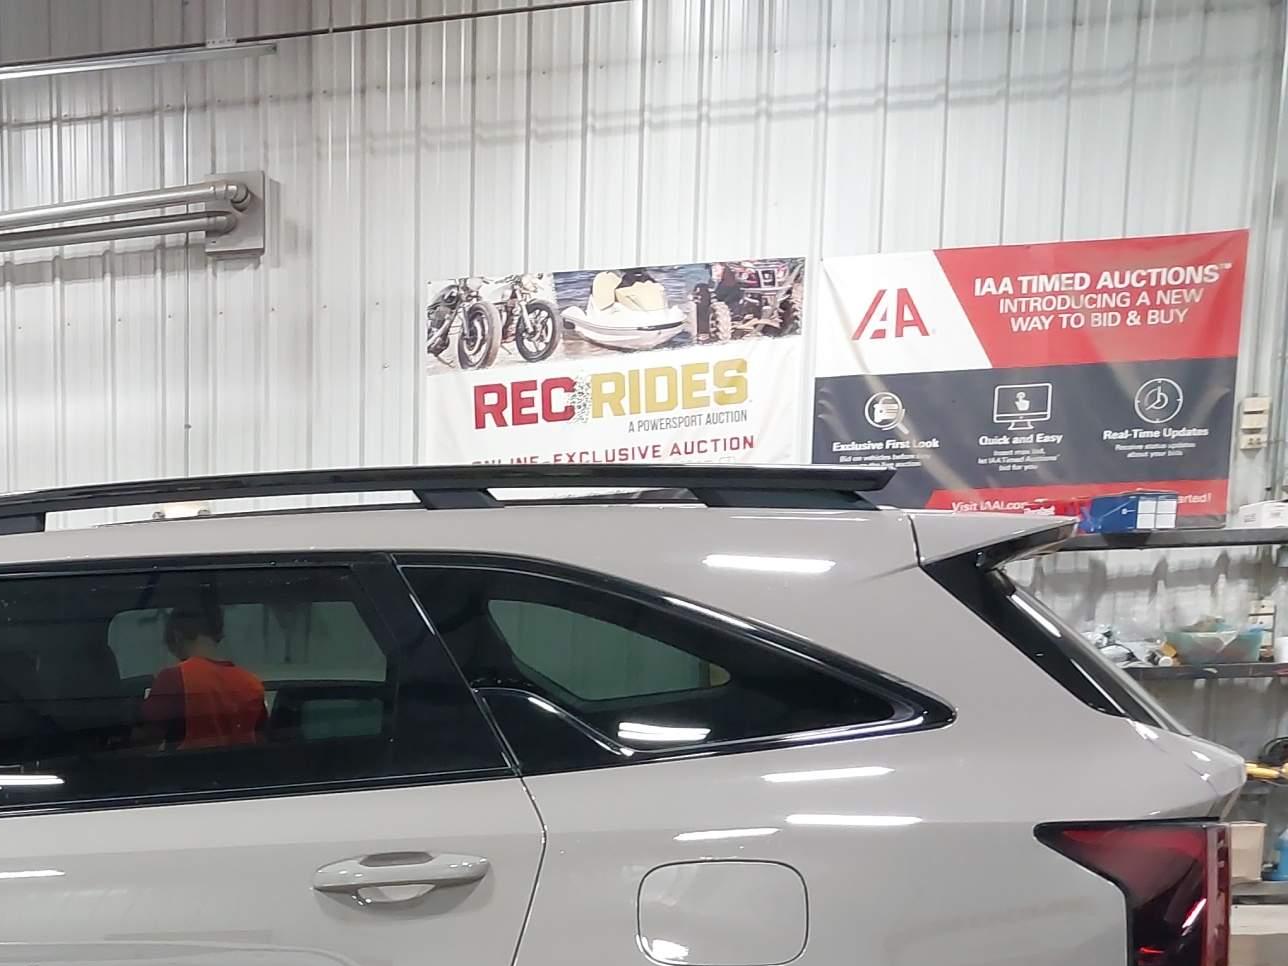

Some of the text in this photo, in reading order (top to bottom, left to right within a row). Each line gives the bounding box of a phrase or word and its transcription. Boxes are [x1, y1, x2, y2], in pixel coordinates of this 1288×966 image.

[974, 277, 1013, 296] IAA
[1017, 273, 1091, 293] TIMED
[999, 288, 1205, 314] INTRODUCING A NEW
[1010, 308, 1190, 332] WAY TO BID & BUY
[474, 358, 749, 429] REC RIDES
[628, 409, 748, 433] A POWERSPORT AUCTION
[979, 433, 1064, 445] Quick and Easy
[1103, 427, 1209, 440] Real-Time Updates
[670, 435, 755, 457] AUCTION
[832, 438, 940, 452] Exclusive First Look
[952, 501, 978, 512] Visit
[1177, 493, 1212, 504] arted!
